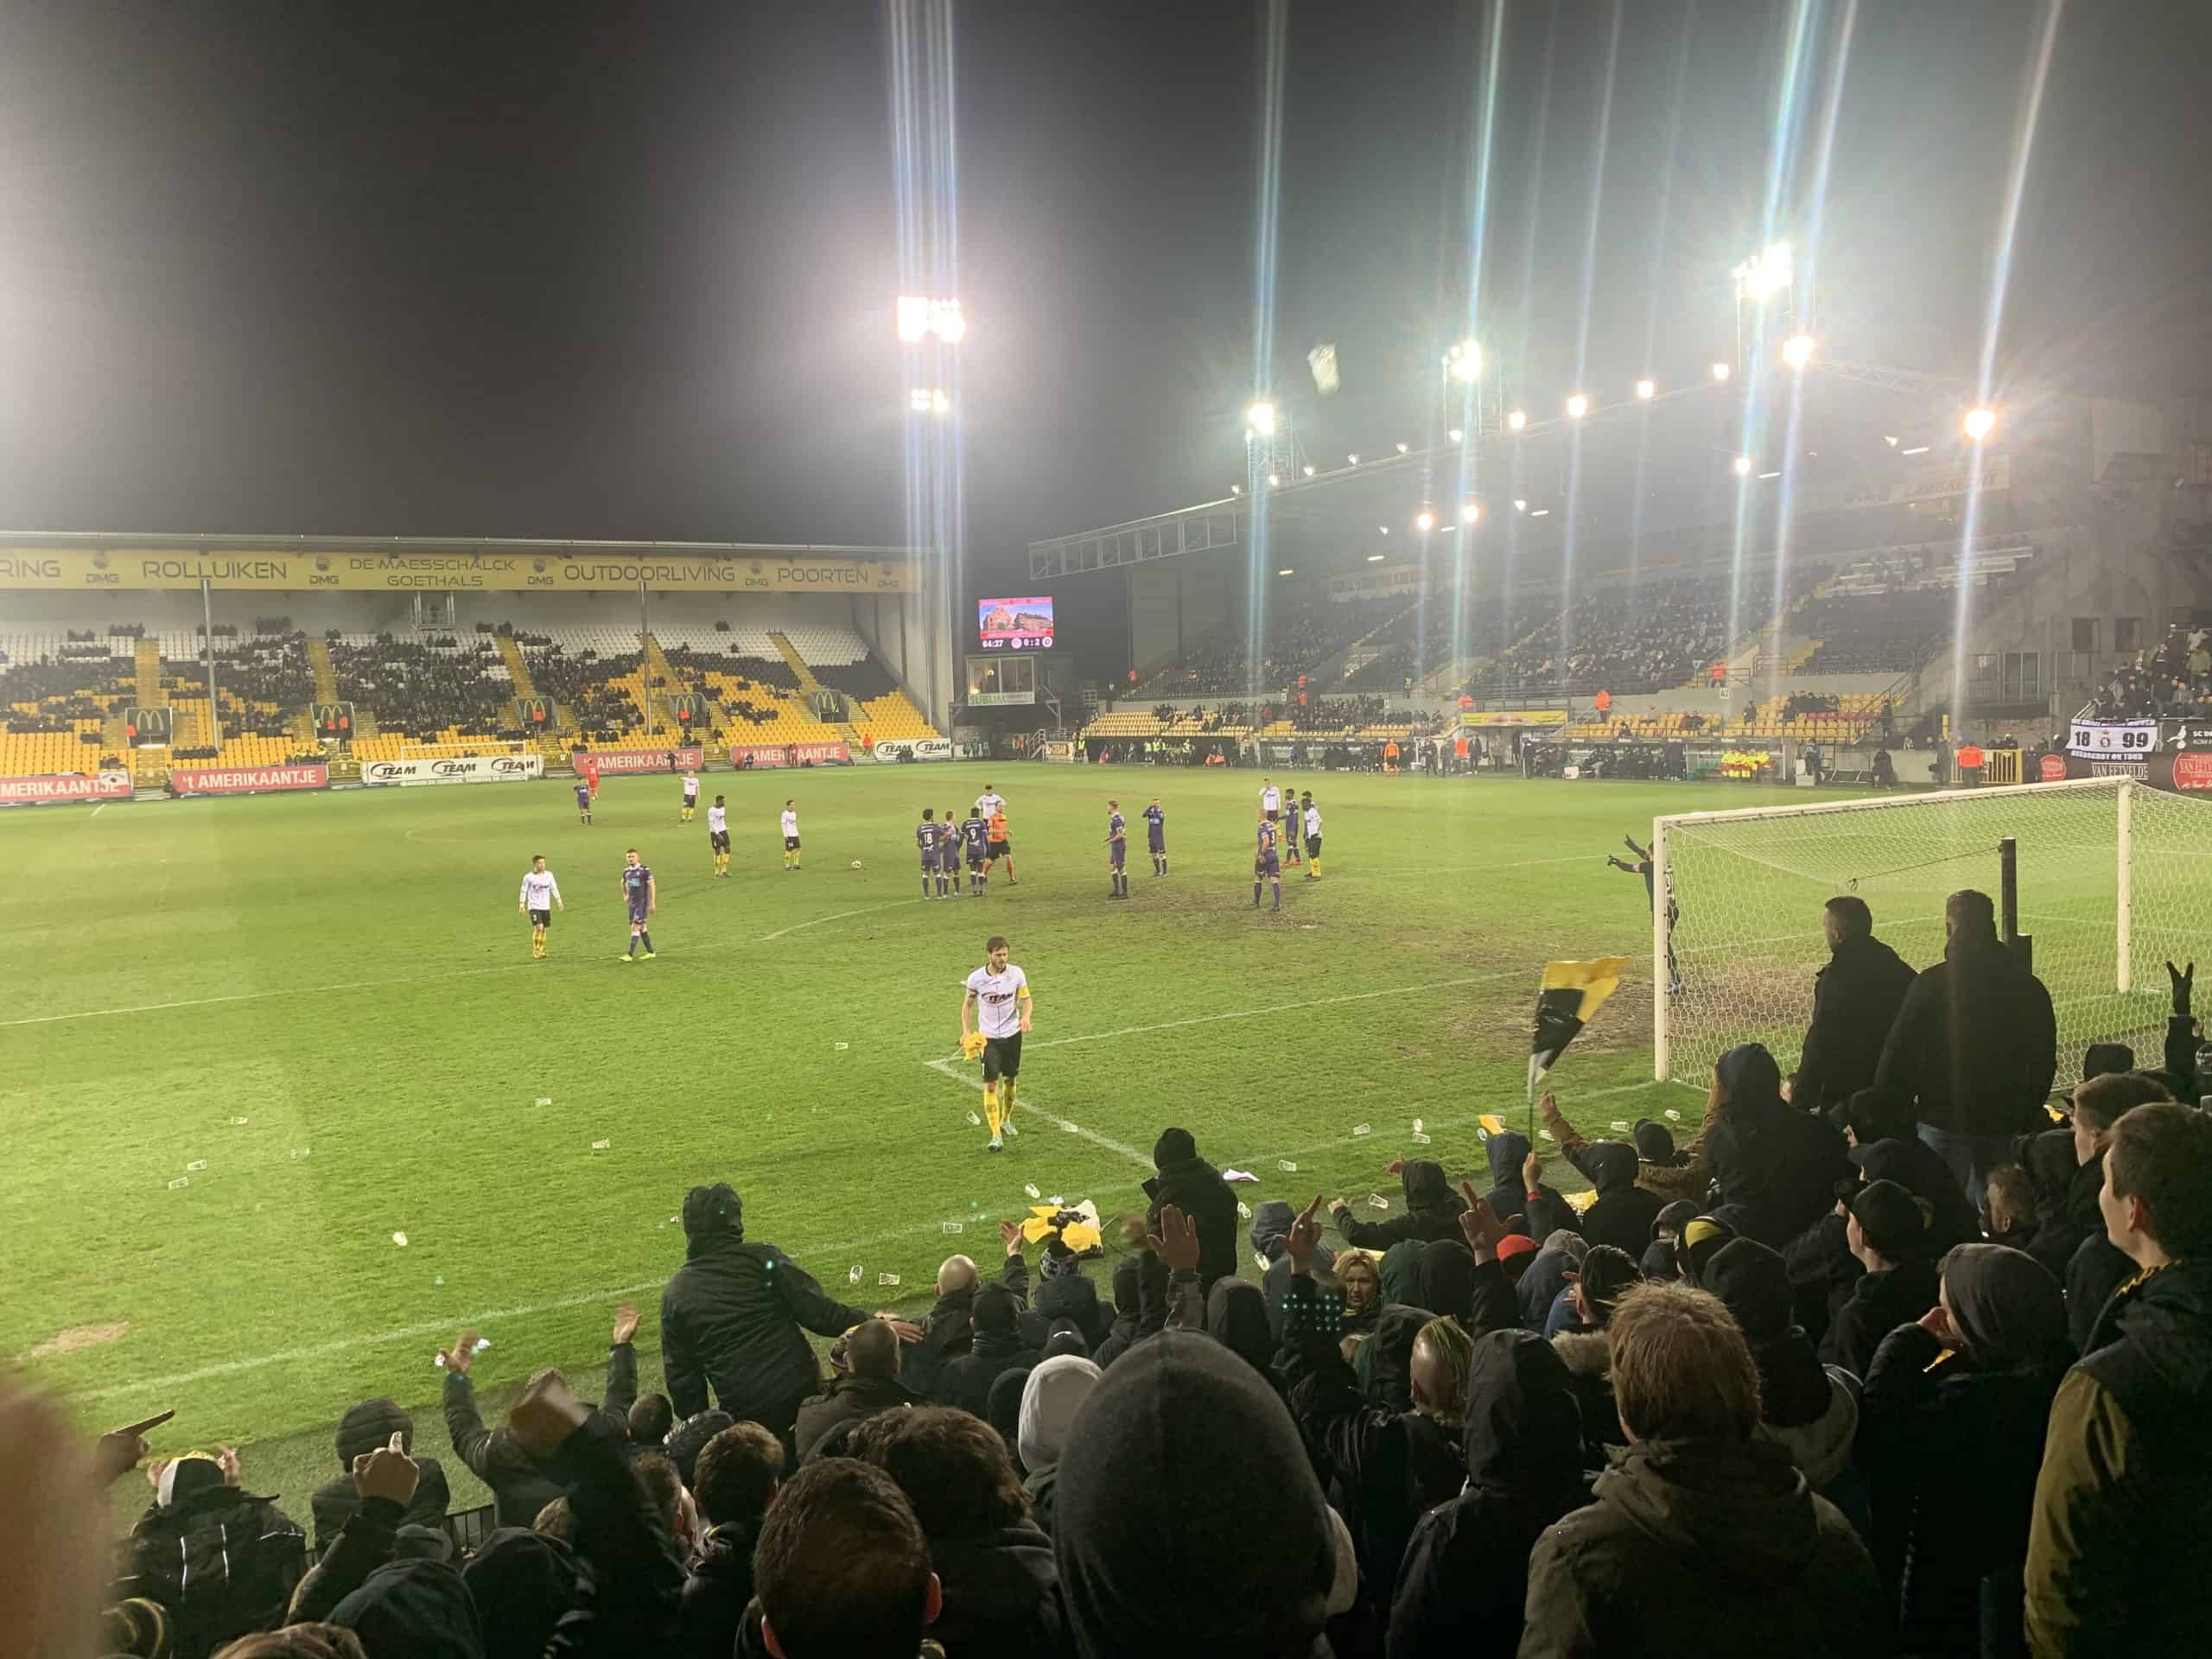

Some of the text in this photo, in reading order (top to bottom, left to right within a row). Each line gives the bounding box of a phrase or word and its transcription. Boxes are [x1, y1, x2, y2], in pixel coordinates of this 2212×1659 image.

[143, 561, 287, 580] ROLLUIKEN
[350, 559, 514, 571] DE MAESSCHALCK
[86, 574, 119, 583] DMG
[309, 575, 340, 584] DMG
[564, 565, 734, 582] OUTDOORLIVING
[778, 567, 870, 584] POORTEN
[387, 575, 483, 587] GOETHALS
[527, 576, 553, 585] DMG
[745, 578, 769, 587] DMG
[2075, 731, 2148, 747] 18 99
[753, 746, 841, 761] AMERAANTJE
[382, 766, 416, 776] TEAM
[442, 762, 476, 773] TEAM
[2091, 765, 2107, 778] VAN
[199, 770, 317, 788] AMERIKAANTJE
[924, 832, 933, 846] 18
[970, 828, 976, 840] 9
